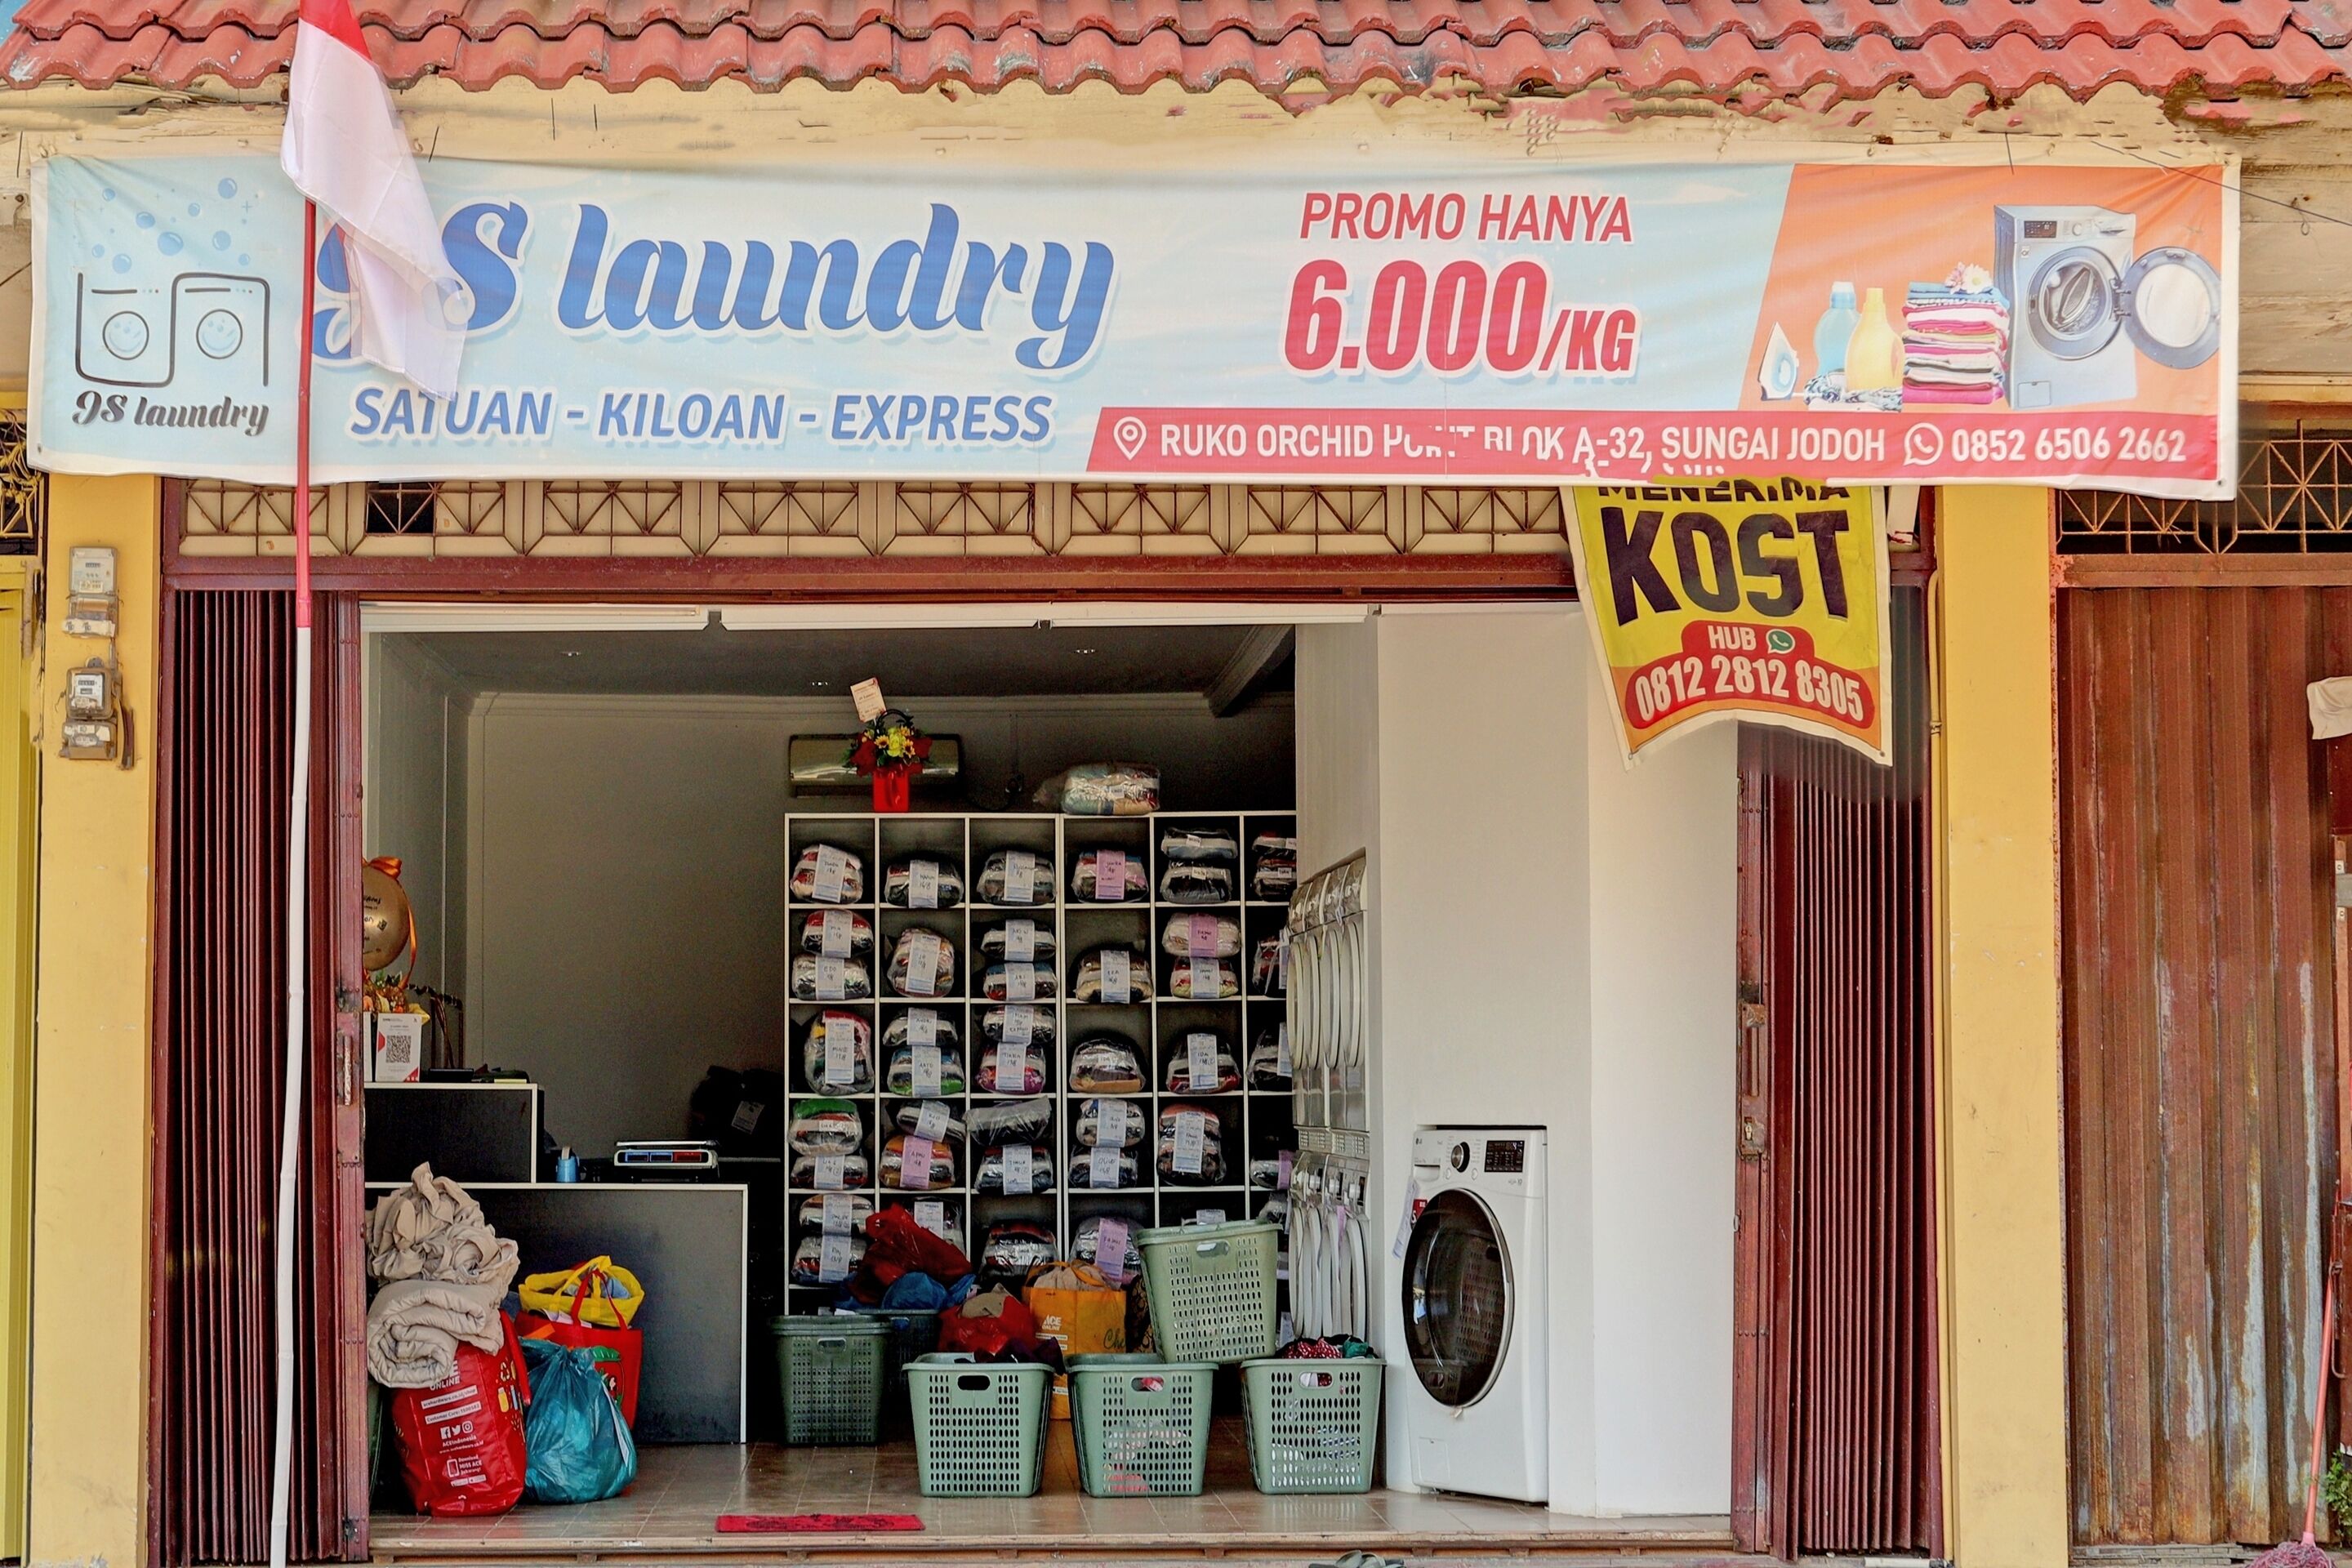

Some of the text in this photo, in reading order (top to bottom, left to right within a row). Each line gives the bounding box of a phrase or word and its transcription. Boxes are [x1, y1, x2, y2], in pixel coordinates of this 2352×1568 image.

[1300, 193, 1632, 243] PROMO HANYA
[558, 203, 1114, 369] laundry
[1284, 259, 1637, 372] 6.000/KG
[133, 395, 269, 437] laundry
[350, 388, 552, 434] SATUAN
[599, 393, 785, 439] KILOAN
[831, 394, 1052, 441] EXPRESS
[1161, 424, 1246, 457] RUKO
[1257, 425, 1374, 457] ORCHID
[1661, 427, 1779, 461] SUNGAI
[1788, 428, 1885, 463] JODOH
[1952, 428, 2186, 463] 0852 6506 2662
[1601, 506, 1851, 626] KOST
[1708, 626, 1757, 651] HUB
[1635, 655, 1864, 722] 0812 2812 8305
[430, 1375, 461, 1391] ONLINE
